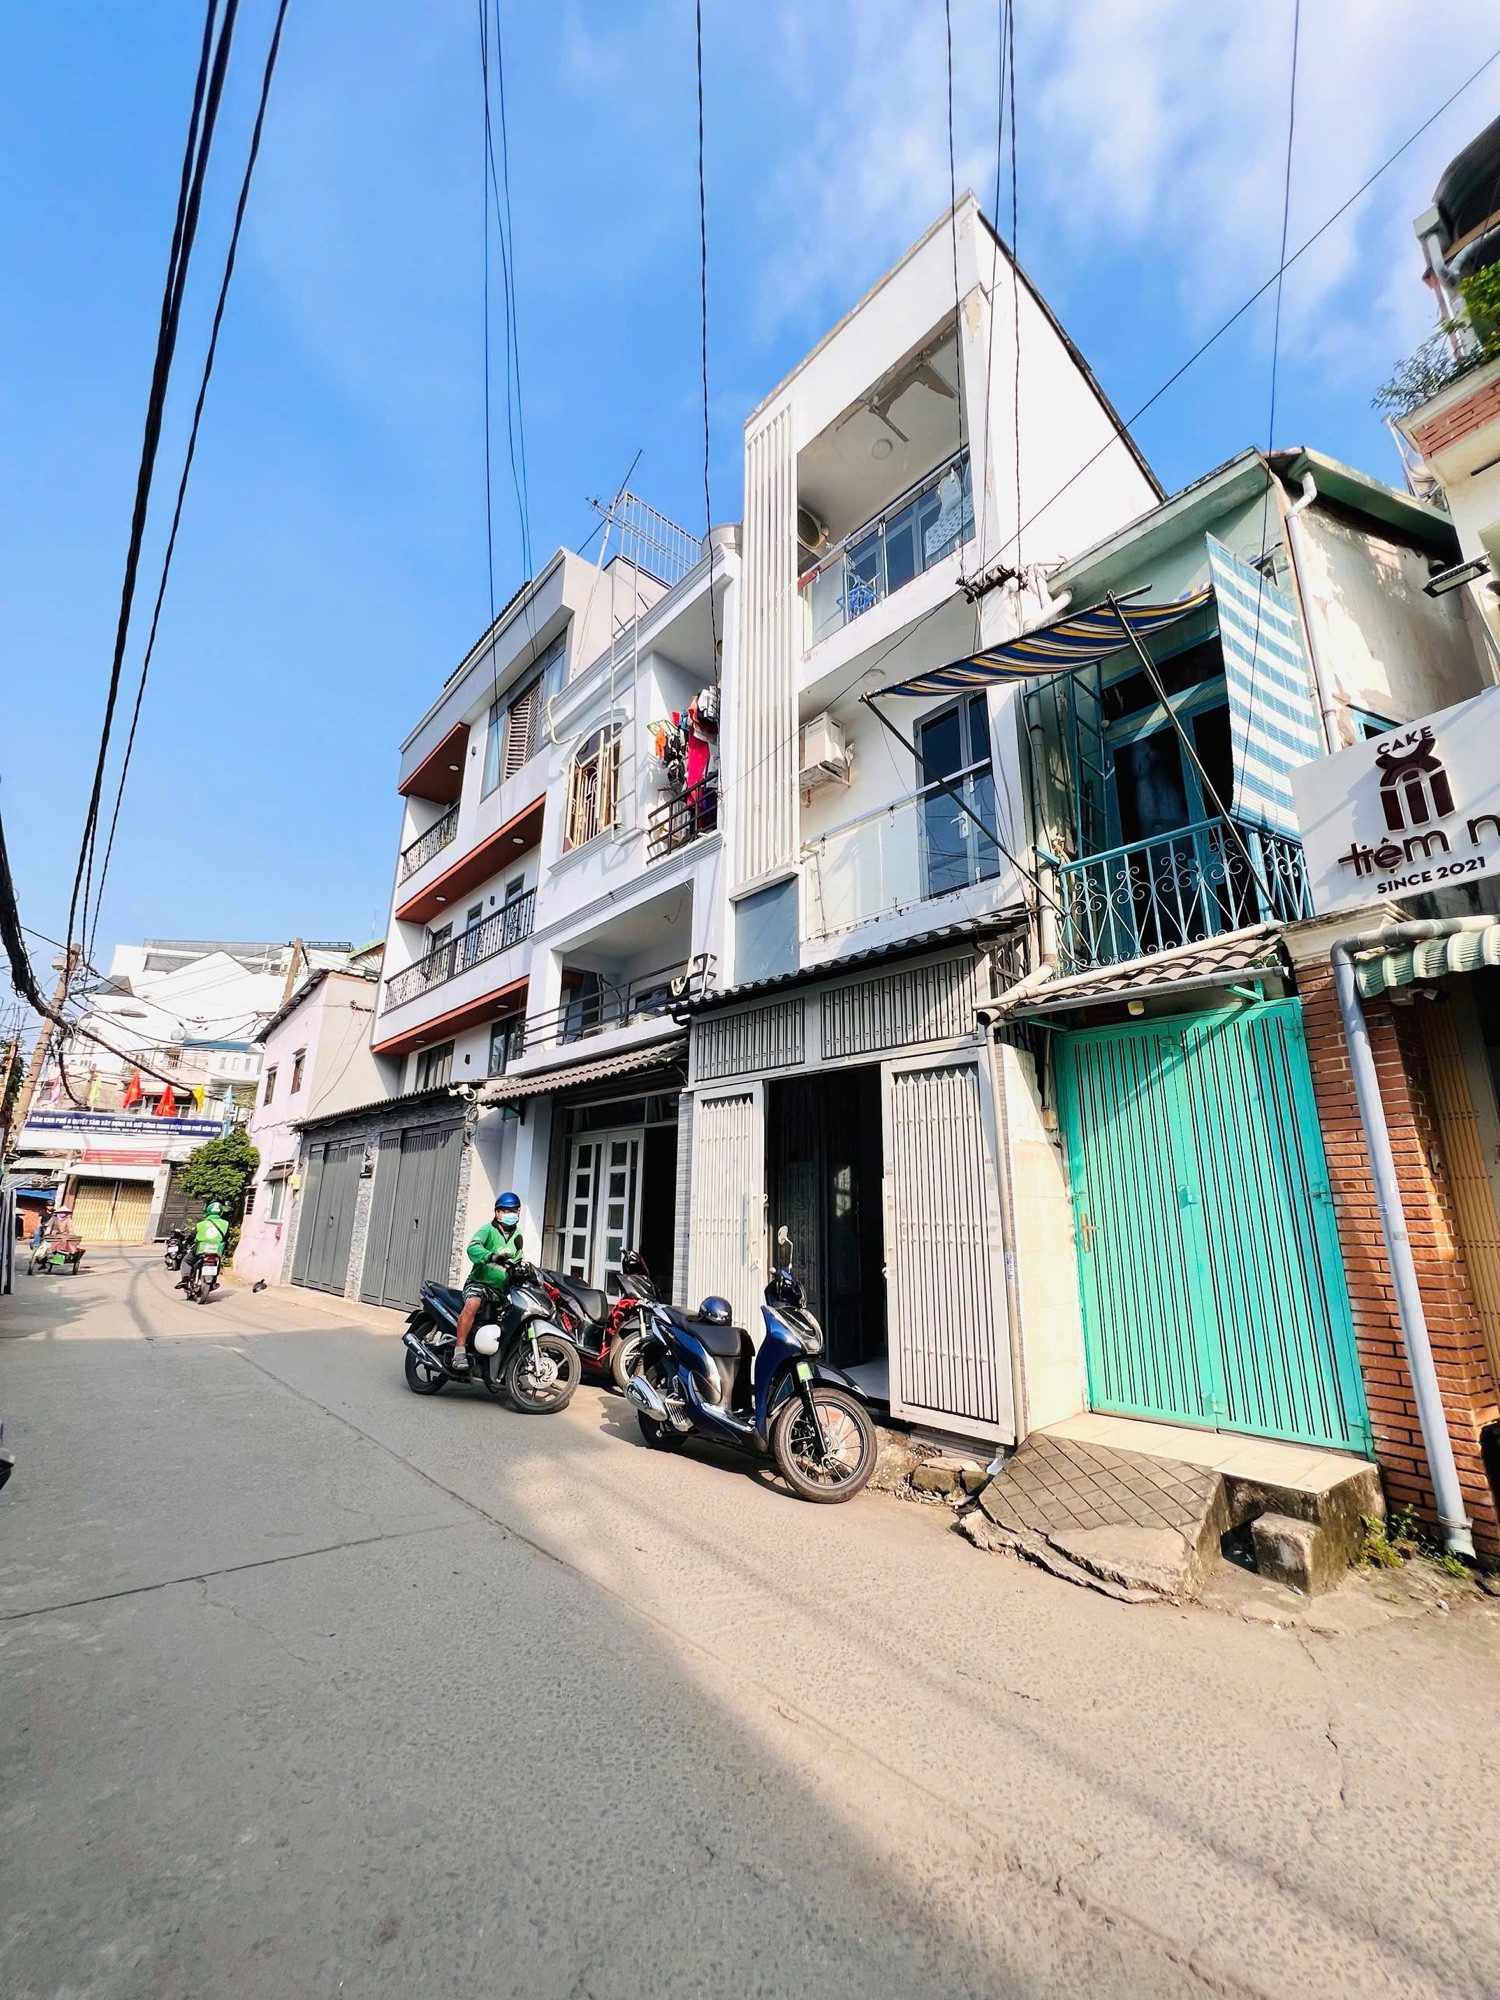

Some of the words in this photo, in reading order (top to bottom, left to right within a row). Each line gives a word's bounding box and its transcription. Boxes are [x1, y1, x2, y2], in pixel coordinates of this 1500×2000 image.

[1377, 725, 1434, 754] CAKE
[1338, 830, 1450, 876] tiệm
[1377, 870, 1432, 894] SINCE
[1437, 856, 1486, 880] 2021
